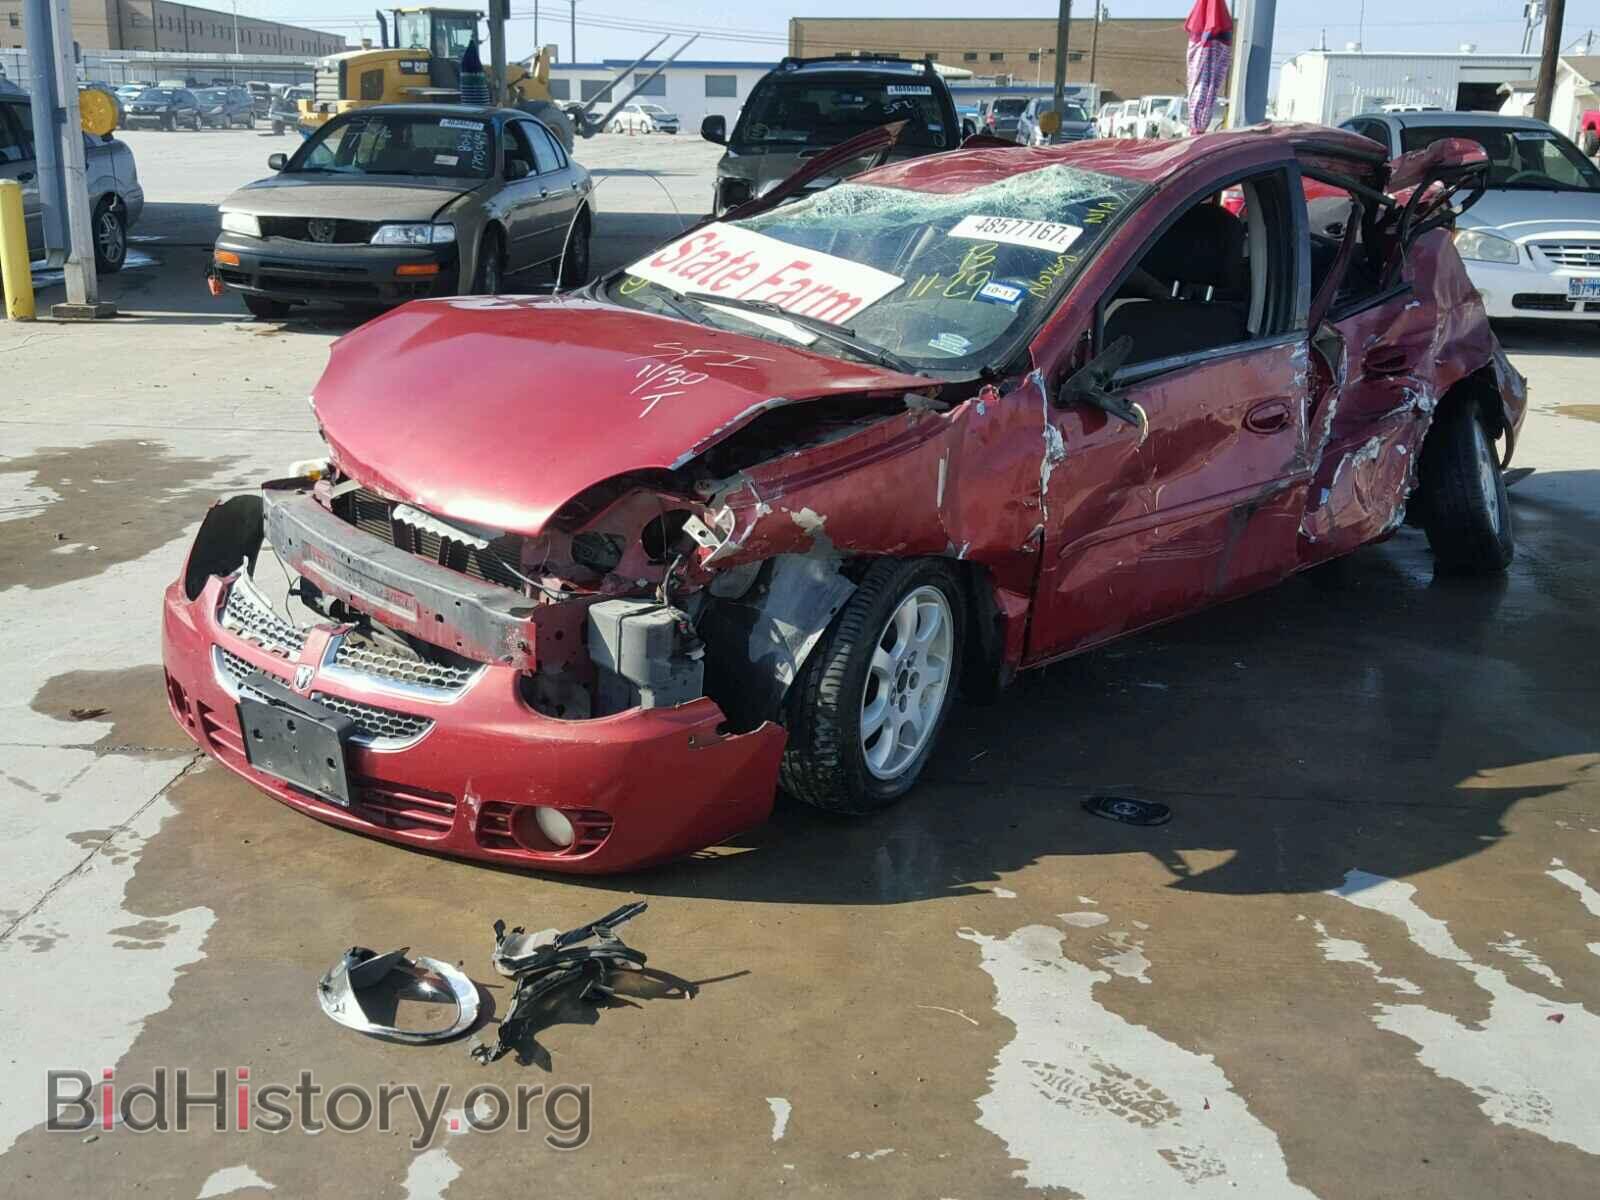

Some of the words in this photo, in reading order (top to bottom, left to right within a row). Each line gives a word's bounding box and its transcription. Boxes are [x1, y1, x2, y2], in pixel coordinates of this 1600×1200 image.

[414, 61, 428, 73] CAT
[975, 216, 1067, 243] 48577167
[649, 231, 761, 292] State
[735, 260, 863, 325] Farm
[629, 363, 709, 394] 11/30
[639, 390, 687, 419] T
